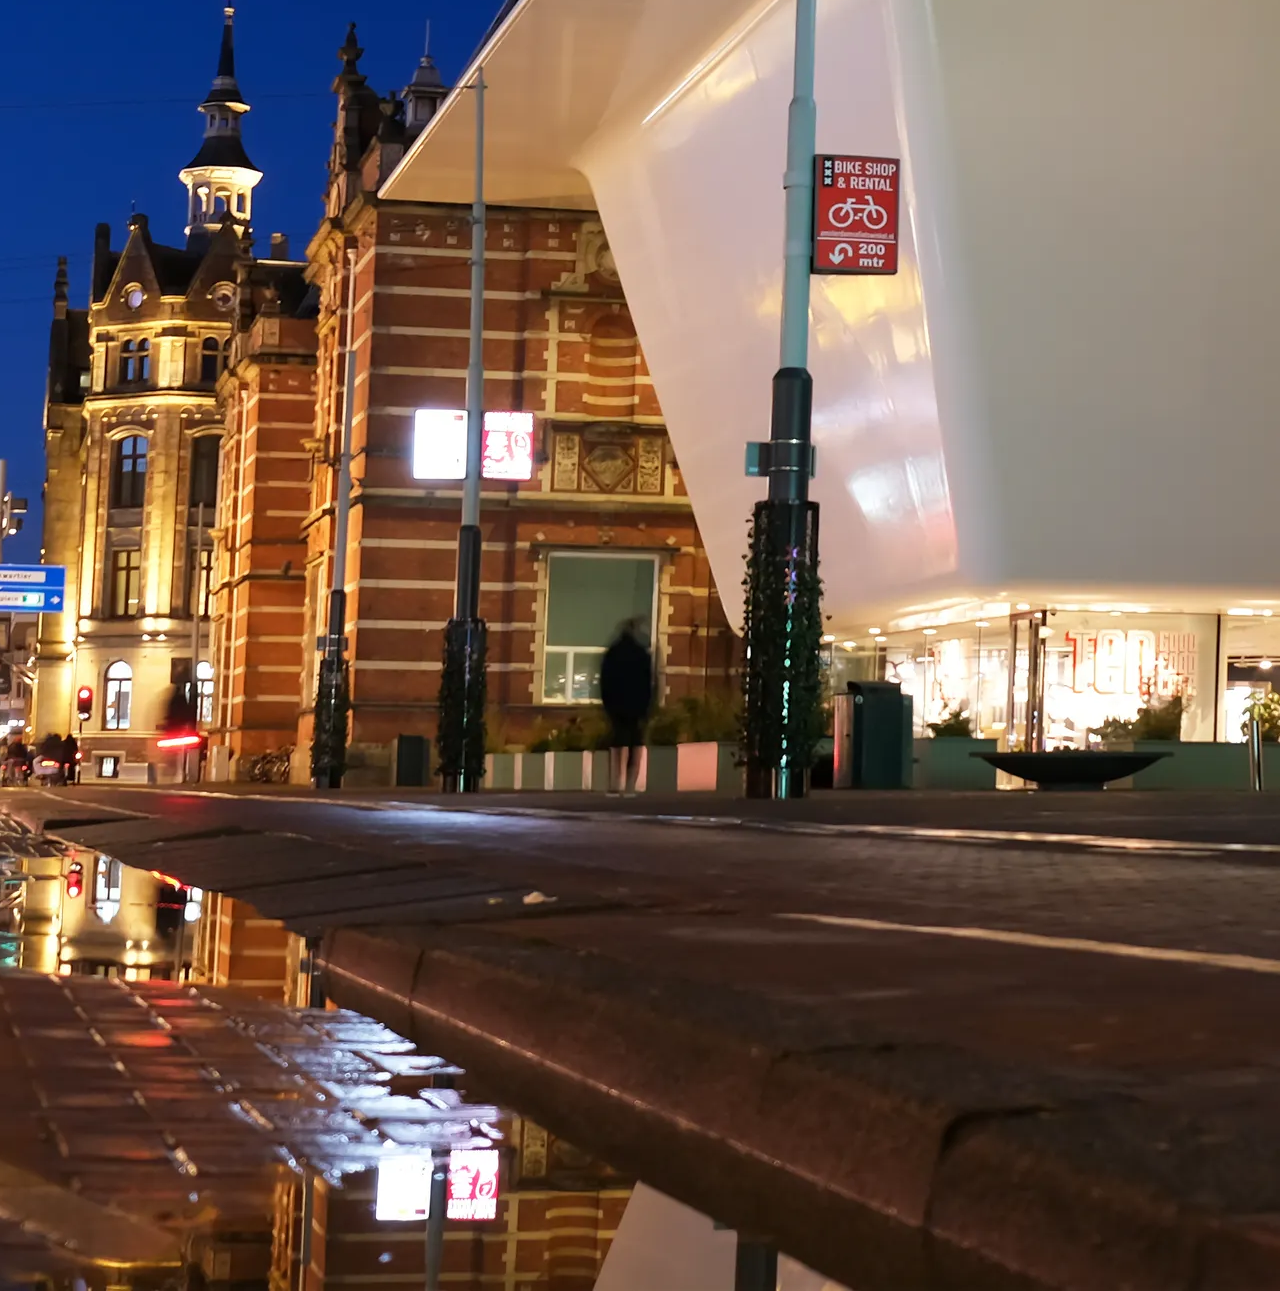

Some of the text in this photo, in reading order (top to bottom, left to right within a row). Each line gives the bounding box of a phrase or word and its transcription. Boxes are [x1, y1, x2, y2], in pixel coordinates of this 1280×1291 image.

[834, 160, 897, 177] BIKE SHOP
[837, 176, 894, 191] & RENTAL
[858, 243, 886, 255] 200
[859, 256, 885, 268] mtr
